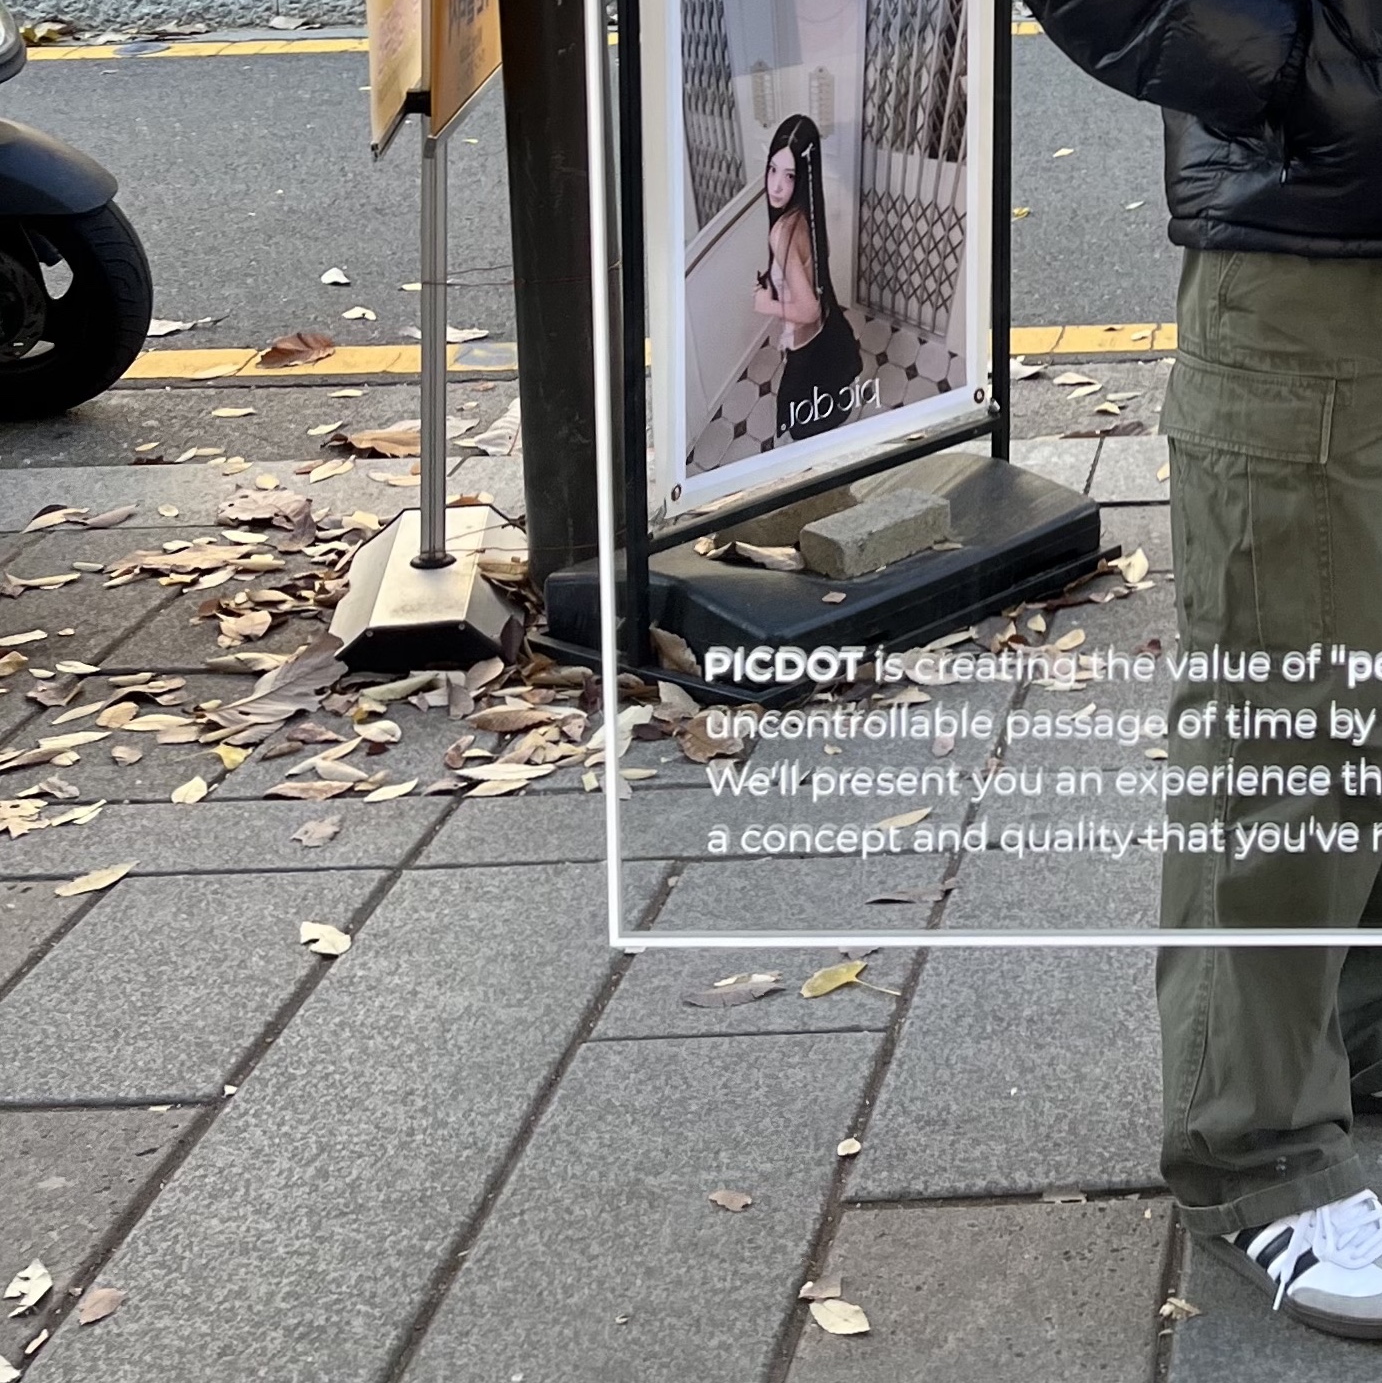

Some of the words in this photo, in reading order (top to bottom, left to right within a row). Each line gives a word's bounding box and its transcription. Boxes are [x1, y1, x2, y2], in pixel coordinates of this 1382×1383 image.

[704, 649, 864, 682] PICDOT
[875, 648, 904, 682] is
[914, 649, 1077, 689] creating
[1090, 648, 1156, 682] the
[1167, 647, 1271, 682] value
[1281, 647, 1321, 682] of
[705, 704, 993, 740] uncontrollable
[1006, 712, 1167, 745] passage
[1178, 703, 1218, 739] of
[1226, 703, 1317, 739] time
[1329, 703, 1377, 745] by
[705, 763, 799, 797] We'll
[811, 768, 960, 802] present
[971, 769, 1043, 802] you
[1055, 770, 1101, 796] an
[1114, 762, 1331, 801] experience
[707, 826, 729, 853] a
[740, 824, 903, 859] concept
[913, 820, 988, 853] and
[999, 820, 1135, 860] quality
[1144, 820, 1225, 853] that
[1234, 817, 1360, 860] you've
